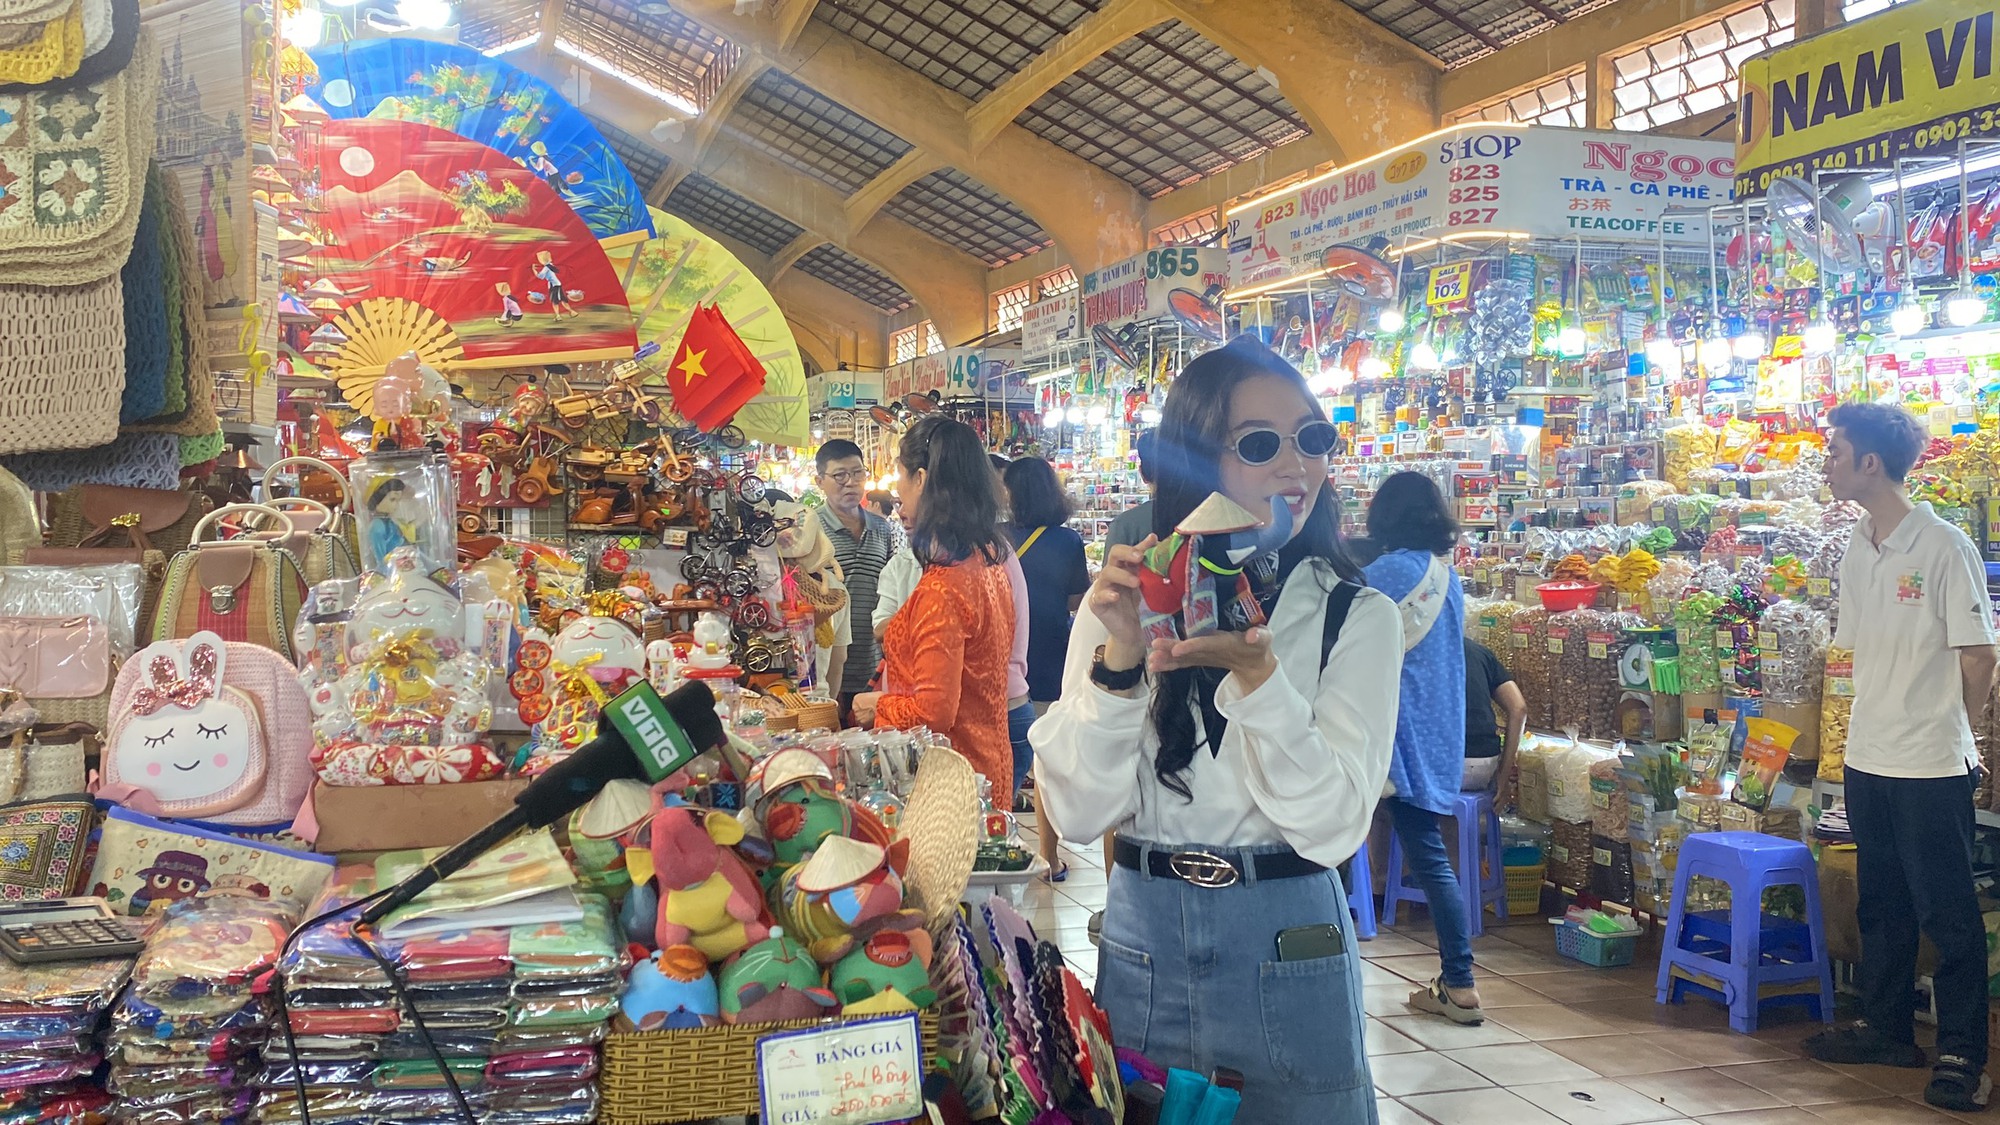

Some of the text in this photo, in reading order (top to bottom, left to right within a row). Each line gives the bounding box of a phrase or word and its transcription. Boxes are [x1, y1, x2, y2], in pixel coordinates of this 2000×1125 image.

[1772, 42, 1904, 138] NAM
[1440, 135, 1522, 164] SHOP
[1812, 151, 1847, 169] 140
[1855, 139, 1889, 166] 111
[1914, 116, 1971, 149] 0902
[1449, 163, 1500, 183] 823
[1583, 140, 1735, 183] Ngọc
[1300, 169, 1378, 221] Ngọc Hoa
[1448, 186, 1500, 204] 825
[1560, 176, 1711, 200] TRÀ CÀ PHÊ
[1264, 201, 1295, 225] 823
[1404, 215, 1432, 234] PRODUCT
[1448, 208, 1499, 227] 827
[1146, 247, 1199, 280] 865
[1438, 266, 1457, 277] SALE
[1434, 281, 1461, 299] 10%
[625, 698, 676, 765] VTC
[815, 1036, 904, 1065] BẢNG GIÁ
[779, 1091, 796, 1101] Tên
